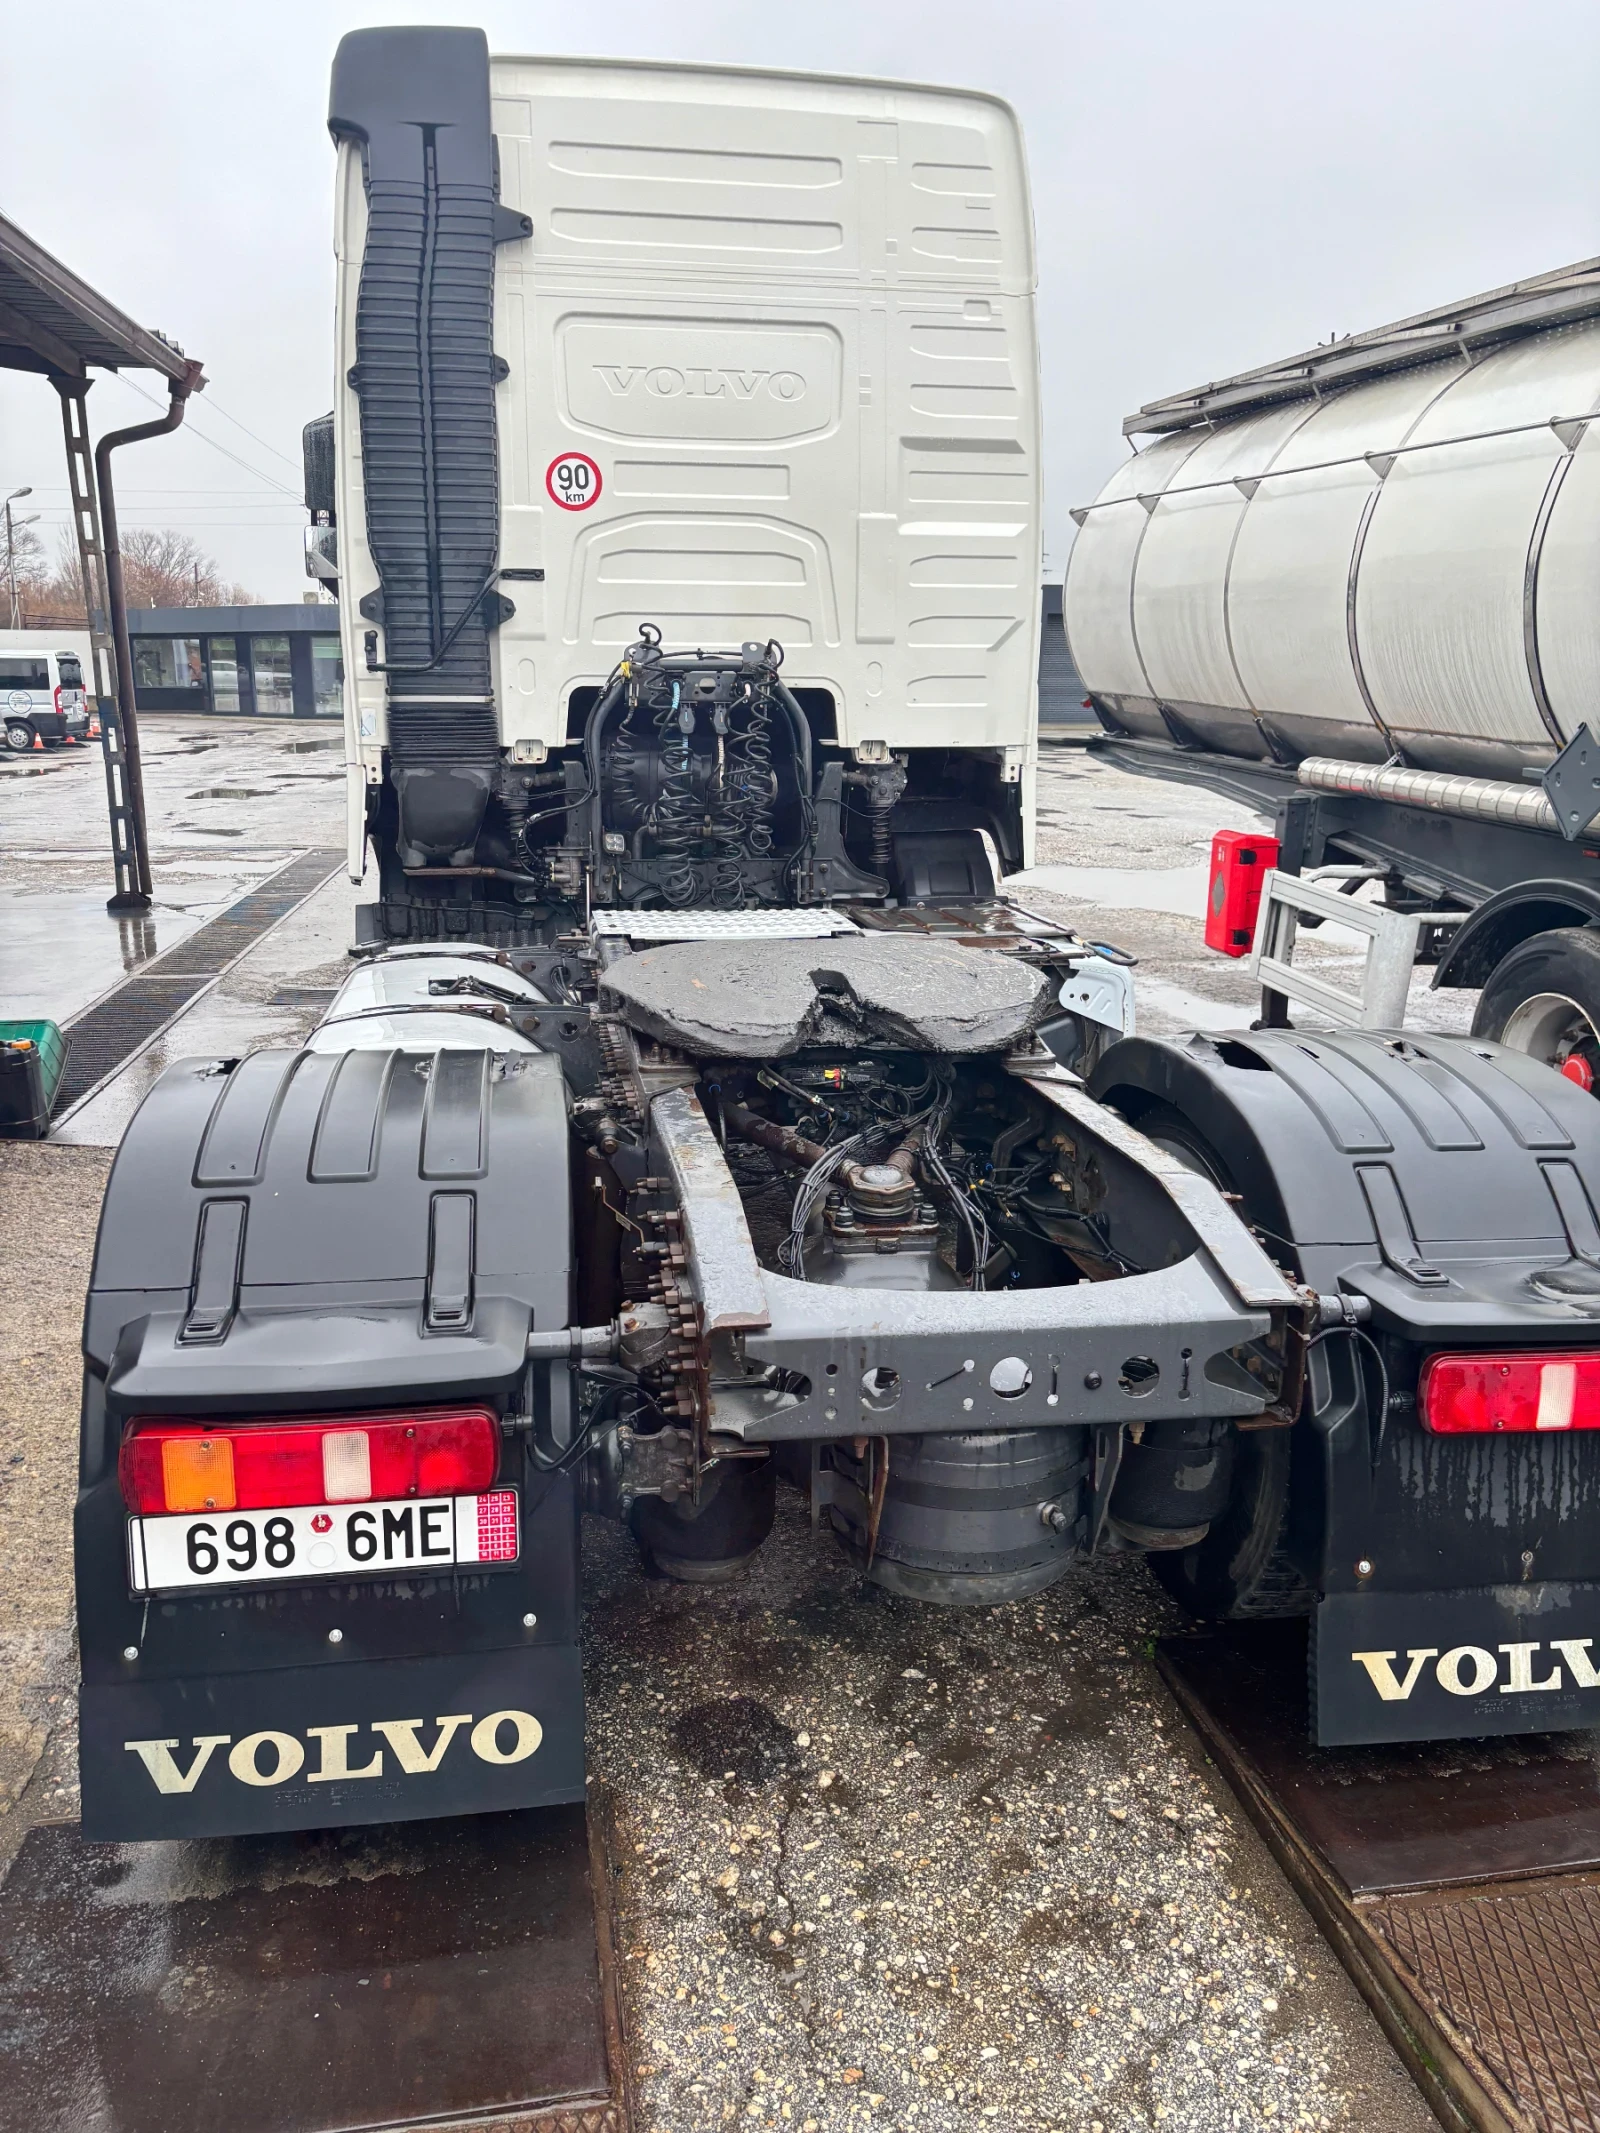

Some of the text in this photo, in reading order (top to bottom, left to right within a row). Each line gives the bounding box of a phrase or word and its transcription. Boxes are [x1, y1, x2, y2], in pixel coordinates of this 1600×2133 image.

[592, 365, 806, 402] VOLVO
[557, 463, 590, 490] 90
[565, 490, 585, 503] km
[187, 1505, 450, 1574] 698 6ME
[125, 1711, 542, 1794] VOLVO
